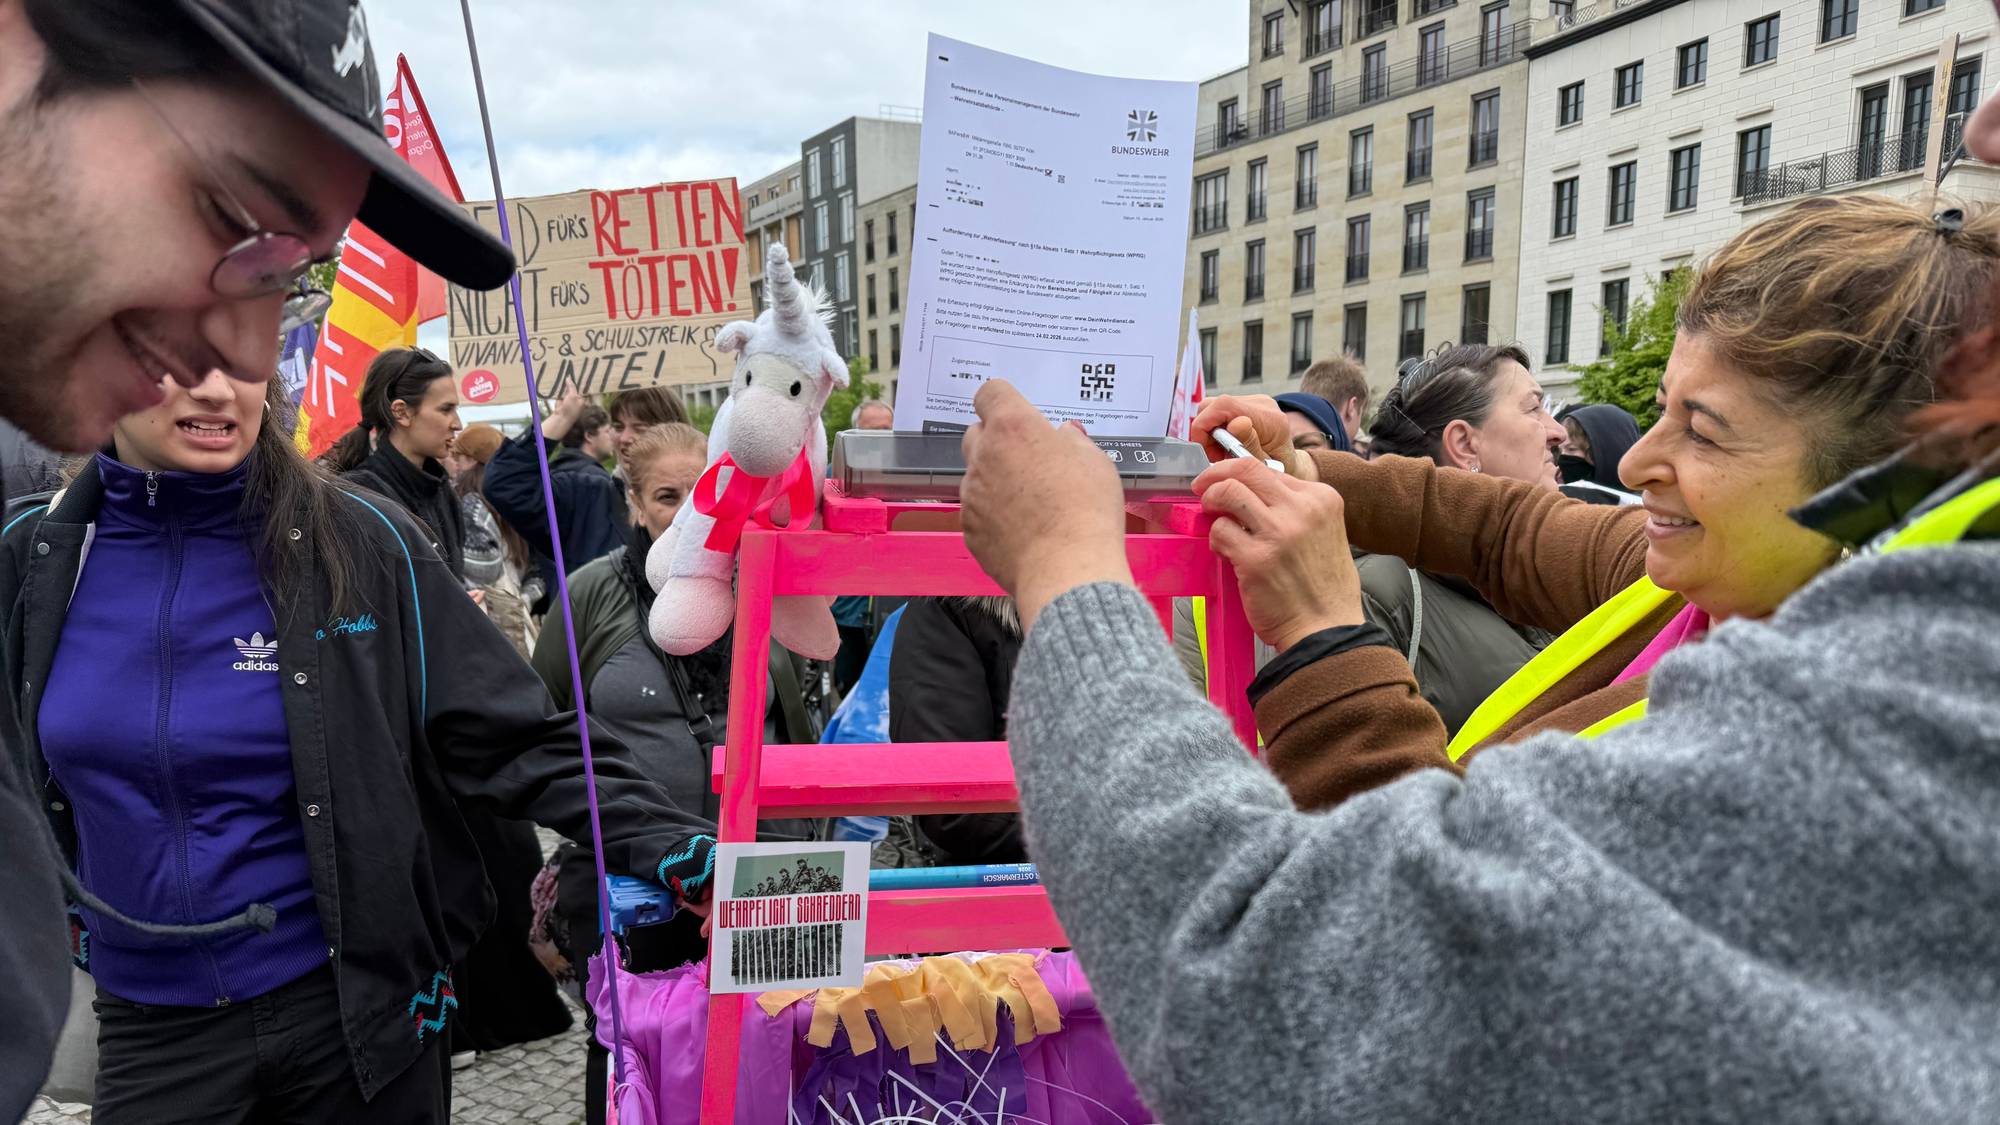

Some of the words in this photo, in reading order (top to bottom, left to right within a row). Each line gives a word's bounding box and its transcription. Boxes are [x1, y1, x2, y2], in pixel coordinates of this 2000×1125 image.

[1051, 107, 1080, 118] Bundeswehr
[1111, 145, 1169, 156] BUNDESWEHR
[547, 214, 589, 243] FÜR'S
[590, 177, 746, 257] RETTEN
[551, 280, 590, 308] FÜR'S
[588, 248, 739, 320] TÖTEN!
[558, 333, 576, 357] &
[580, 324, 701, 353] SCHULSTREIK
[233, 660, 279, 672] adidas
[983, 873, 1034, 882] OSTERMARSCH
[719, 897, 792, 929] WEHRPFLICHT
[796, 894, 861, 924] SCHREDDERN
